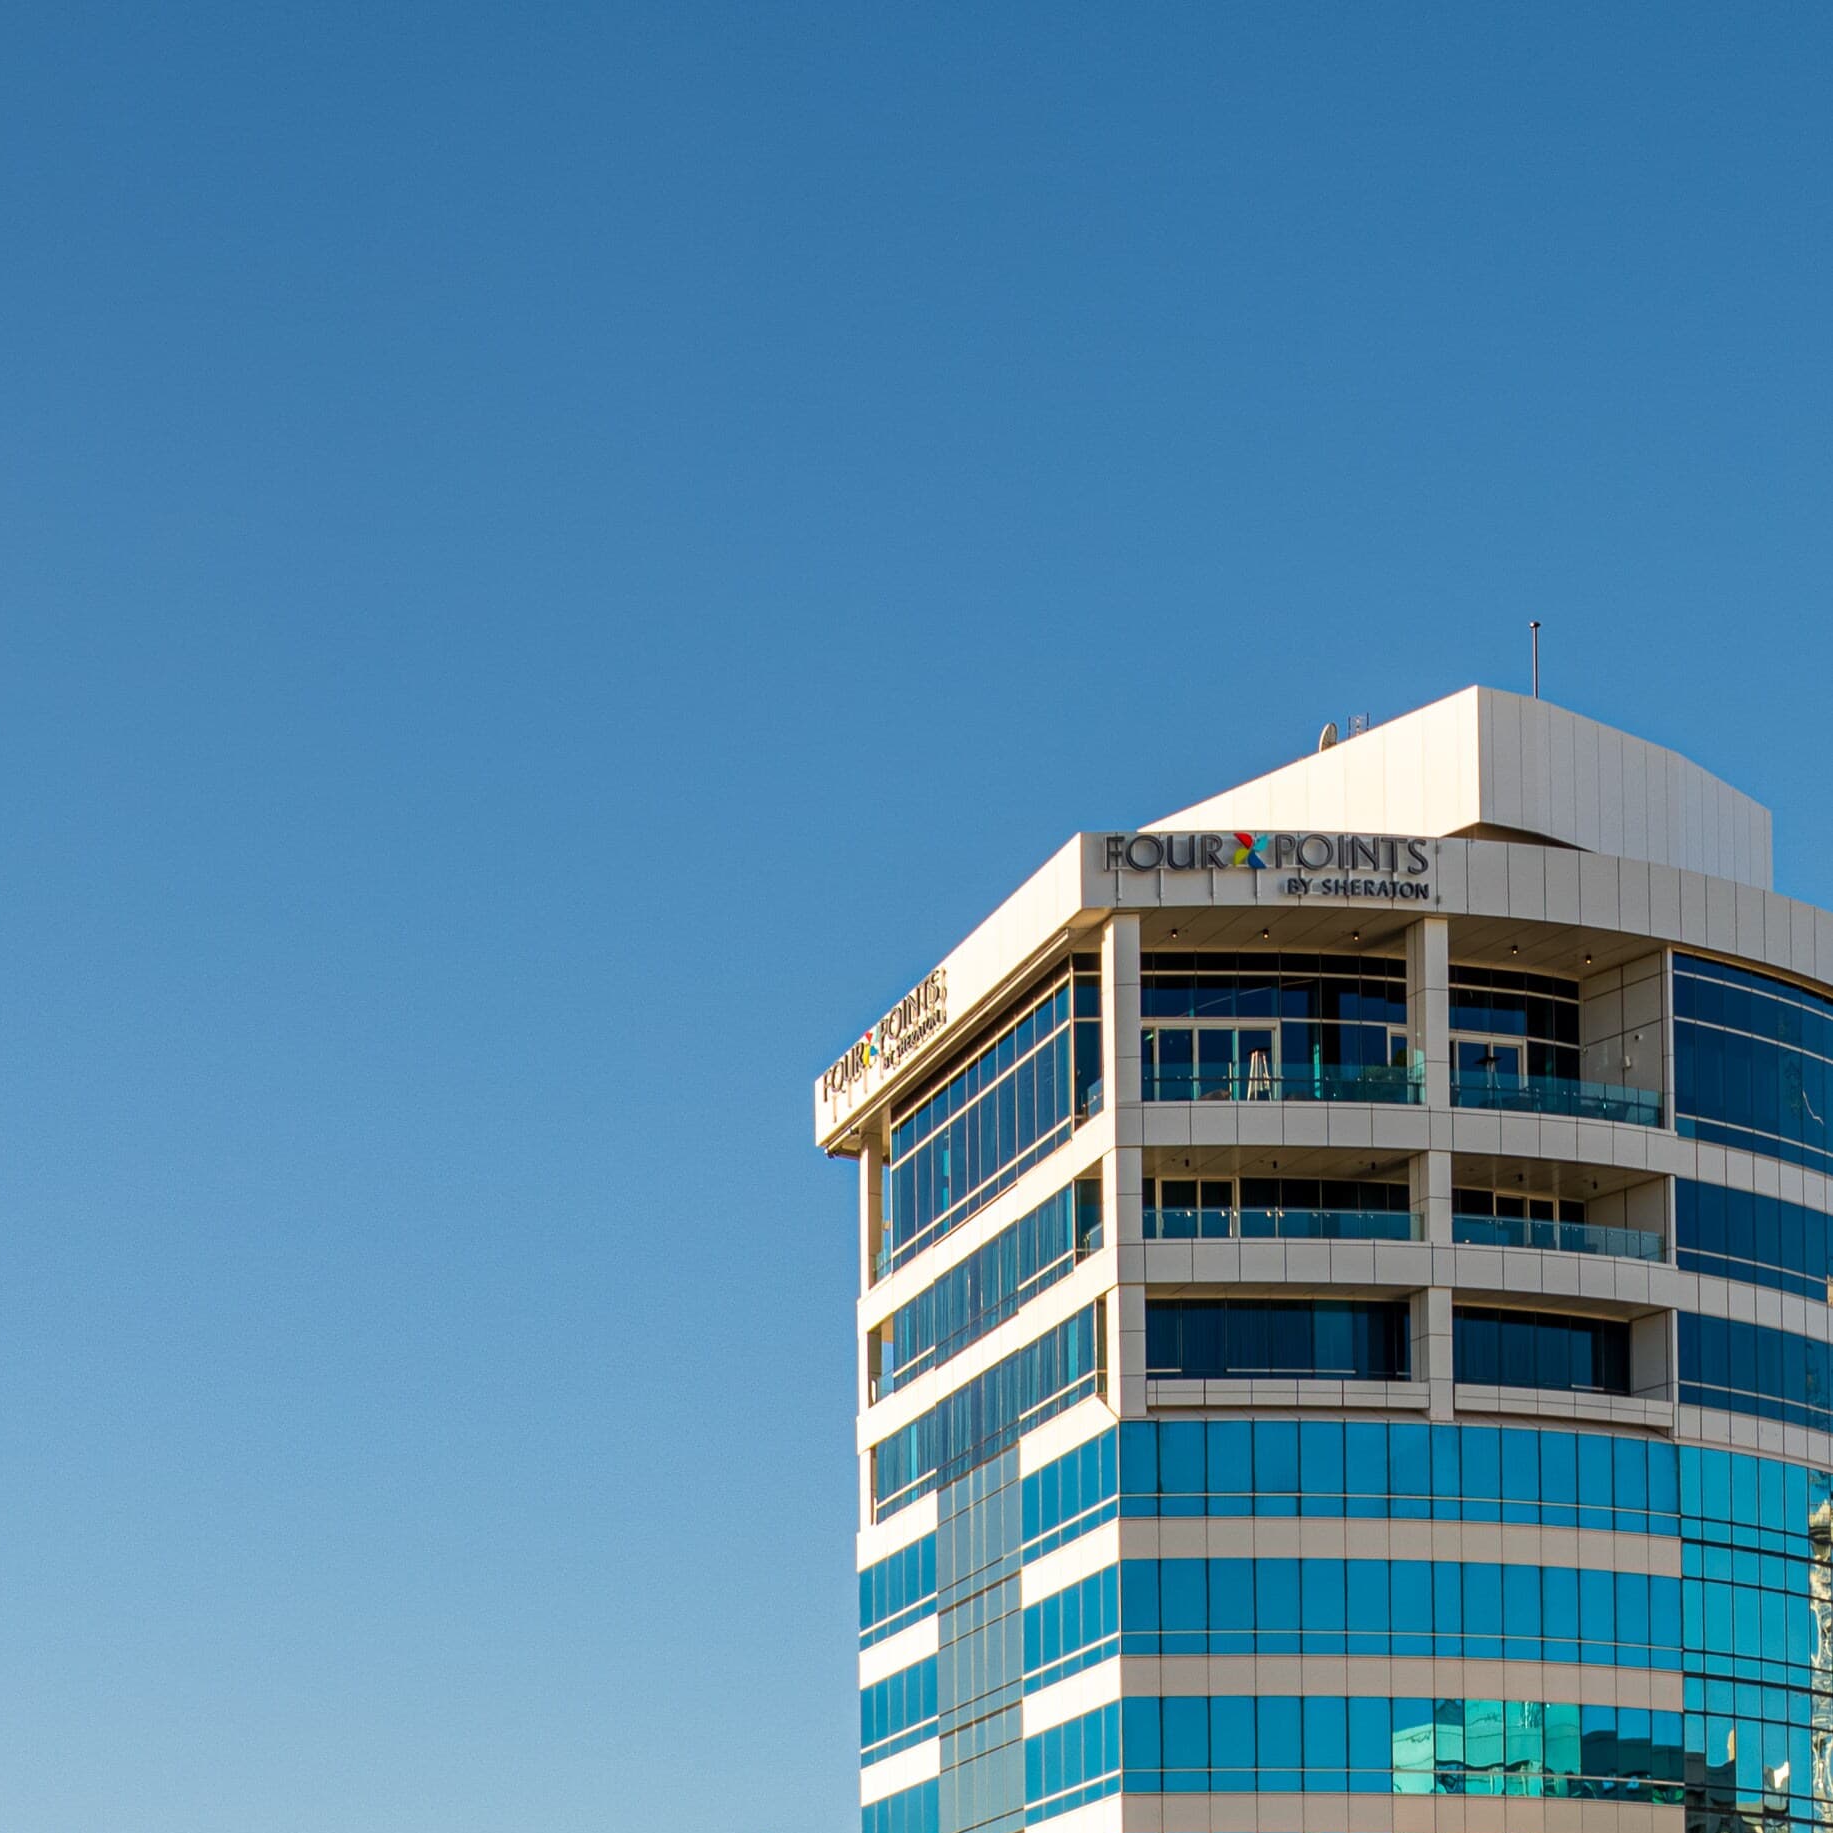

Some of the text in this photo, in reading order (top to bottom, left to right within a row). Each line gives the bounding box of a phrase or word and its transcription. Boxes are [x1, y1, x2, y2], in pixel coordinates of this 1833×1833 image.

[1103, 833, 1430, 875] FOUR POINTS
[1286, 877, 1430, 900] BY SHERATON
[823, 969, 941, 1103] FOUR POINTS
